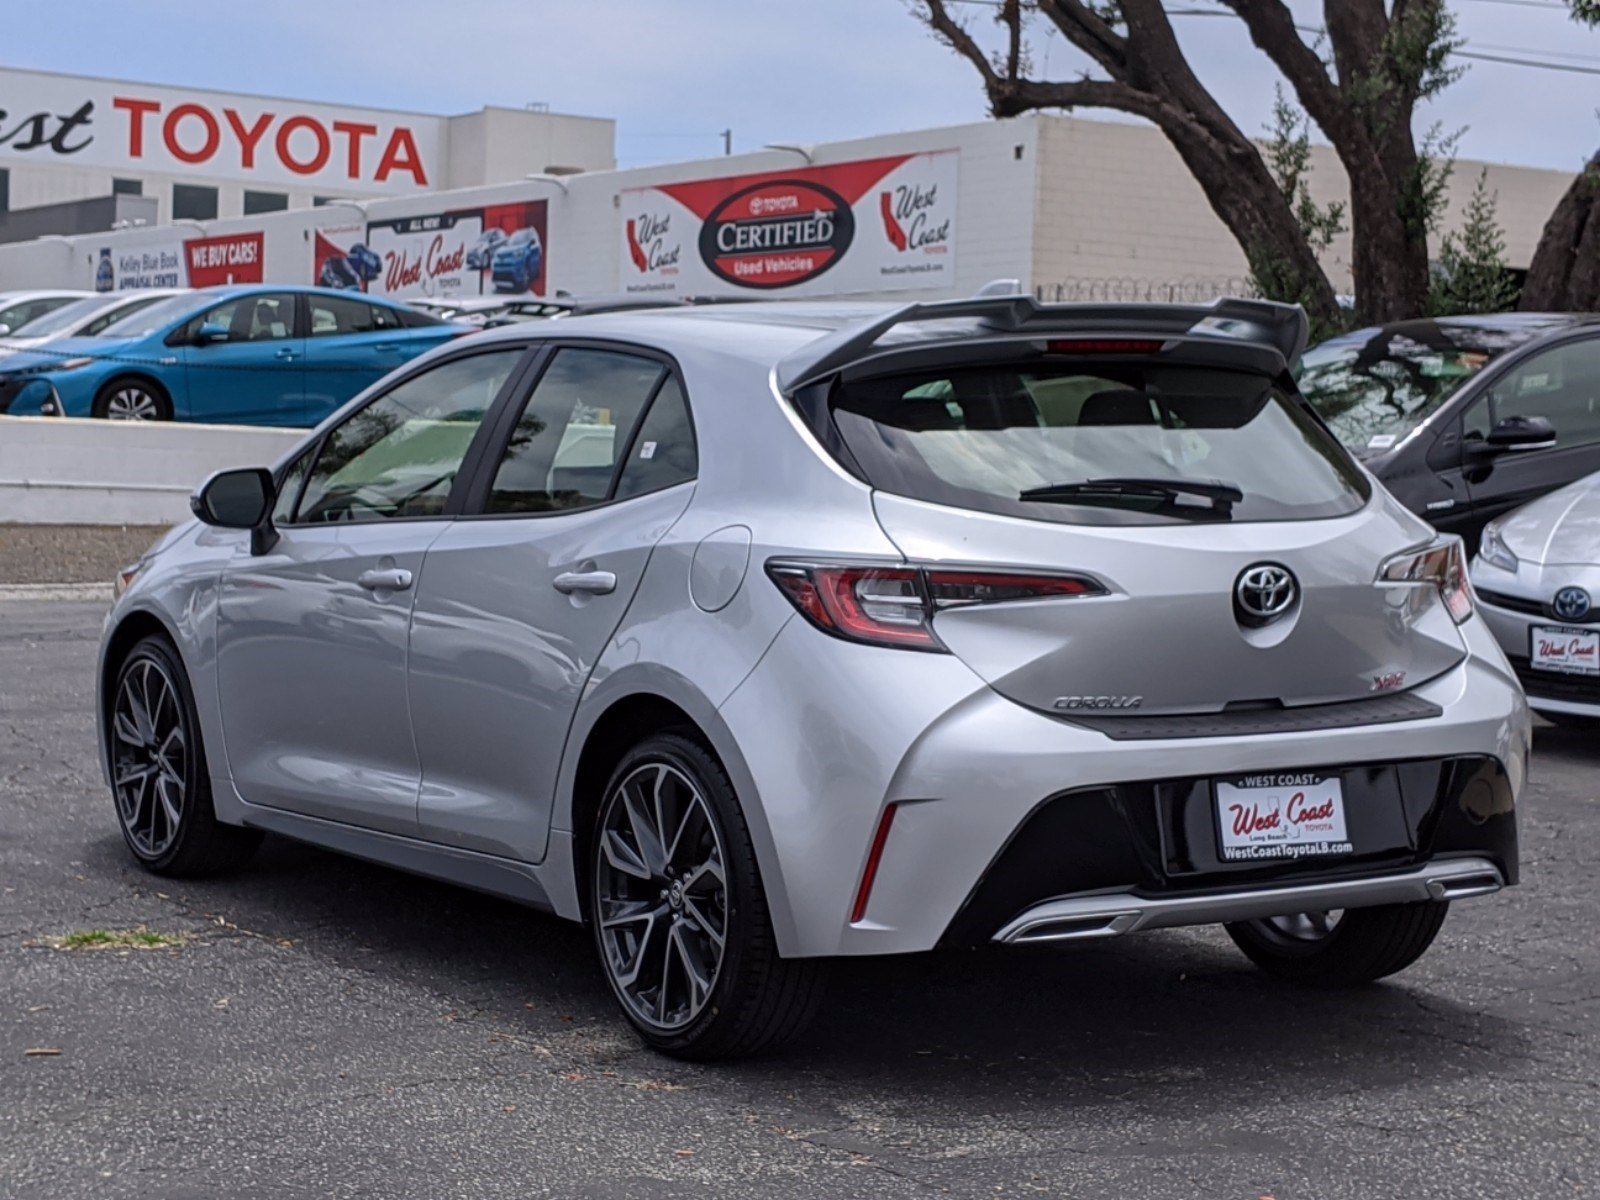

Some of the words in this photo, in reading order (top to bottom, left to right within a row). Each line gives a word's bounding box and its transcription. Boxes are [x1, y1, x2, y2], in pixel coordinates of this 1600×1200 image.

[0, 100, 94, 154] st
[113, 97, 428, 186] TOYOTA
[764, 196, 798, 211] TOYOTA
[896, 184, 937, 219] West
[409, 218, 421, 231] ALL
[639, 214, 670, 243] West
[717, 219, 834, 251] CERTIFIED
[909, 212, 950, 250] Coast
[120, 256, 140, 273] Kelley
[142, 253, 158, 270] Blue
[160, 251, 178, 269] Book
[191, 246, 206, 268] WE
[209, 244, 227, 267] BUY
[228, 241, 258, 264] CARS!
[385, 248, 422, 292] West
[426, 234, 465, 279] Coast
[649, 237, 680, 271] Coast
[734, 259, 763, 275] Used
[764, 256, 814, 273] Vehicles
[119, 275, 152, 290] APPRAISAL
[153, 273, 178, 288] CENTER
[1539, 639, 1565, 656] West
[1568, 638, 1594, 656] Coast
[1053, 695, 1143, 709] COROLLA
[1245, 775, 1275, 787] WEST
[1278, 774, 1315, 786] COAST
[1229, 802, 1280, 836] West
[1286, 792, 1334, 826] Coast
[1224, 842, 1353, 859] WestCoastToyotaLB.com
